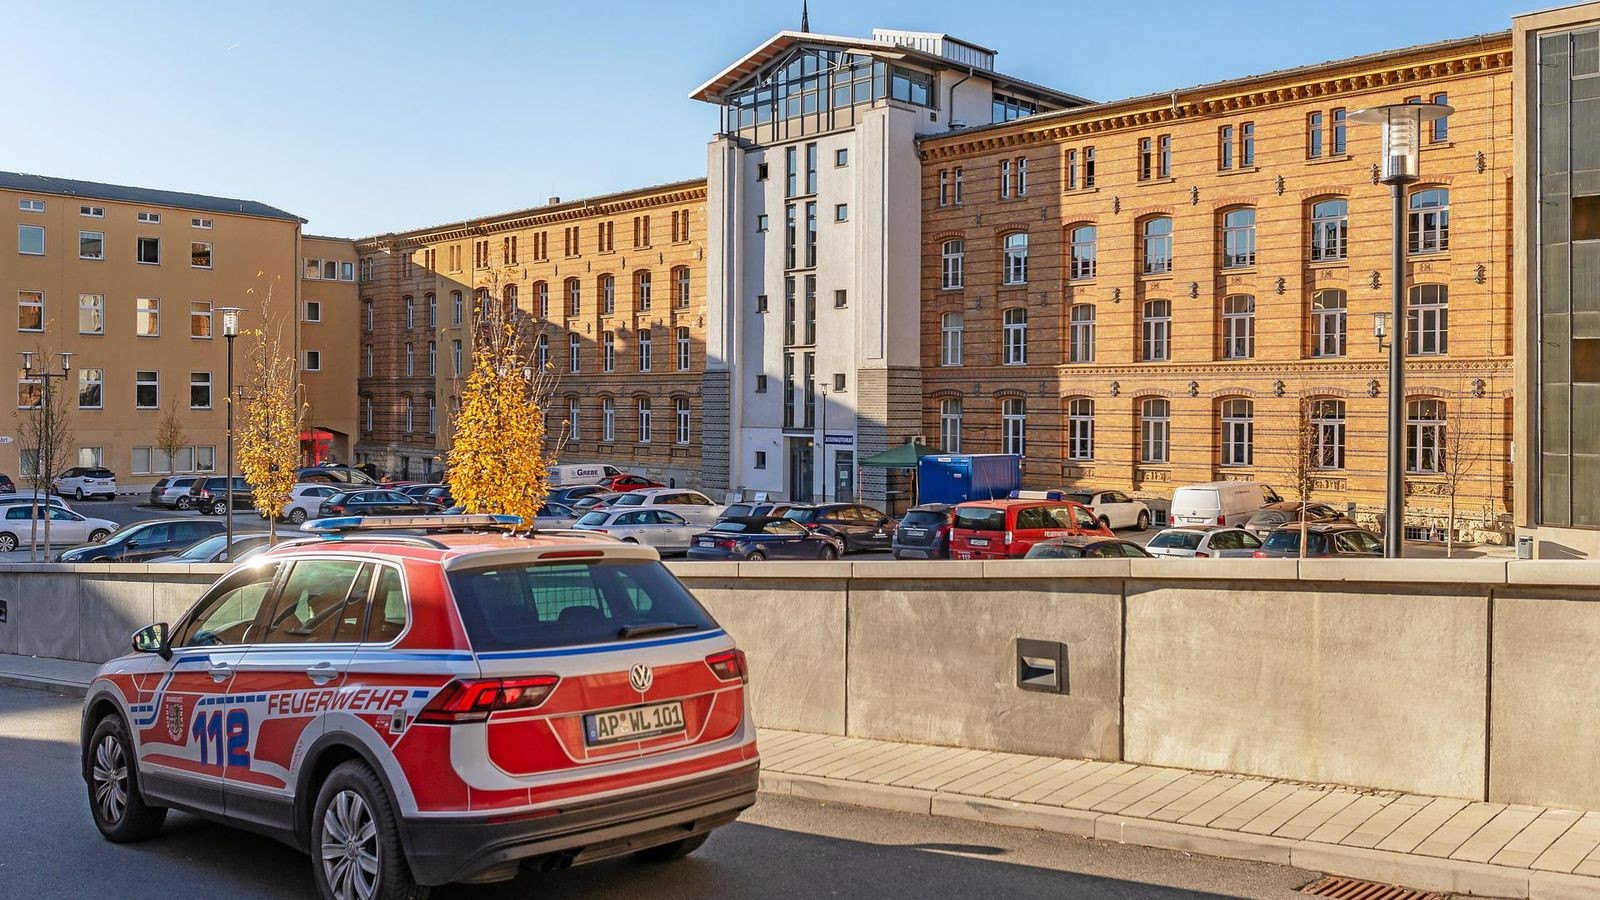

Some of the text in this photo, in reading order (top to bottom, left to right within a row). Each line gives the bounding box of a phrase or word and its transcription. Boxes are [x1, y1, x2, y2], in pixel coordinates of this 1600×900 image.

[267, 689, 407, 715] FEUERWEHR
[192, 708, 250, 768] 112
[598, 715, 619, 738] AP
[629, 710, 652, 732] WL
[653, 705, 682, 728] 101
